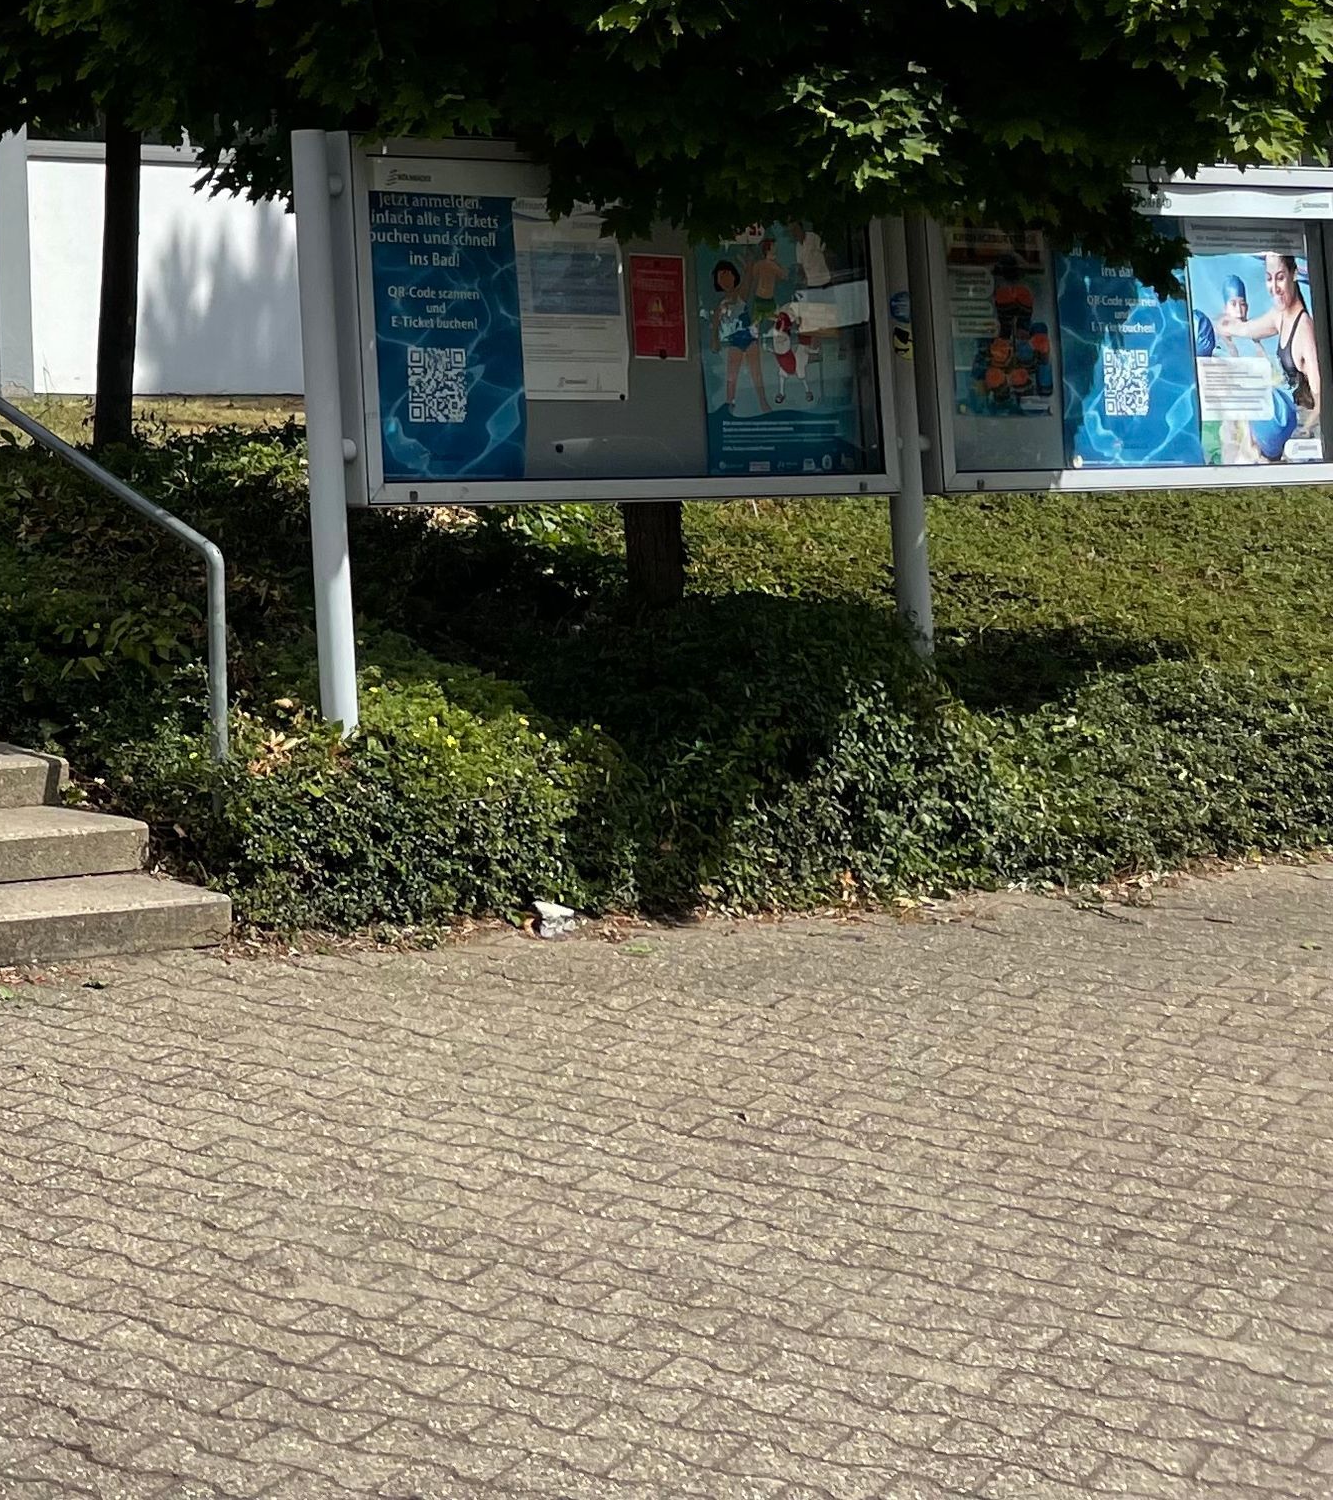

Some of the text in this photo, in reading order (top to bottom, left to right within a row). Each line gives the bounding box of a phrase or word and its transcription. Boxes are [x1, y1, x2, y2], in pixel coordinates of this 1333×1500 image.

[379, 192, 483, 211] Jetzt anmelden.
[371, 209, 499, 229] infach alle E-Tickets
[423, 231, 451, 245] und
[453, 232, 497, 247] schnell
[409, 250, 460, 267] ins Bad!
[387, 285, 480, 301] QR-Code scannen
[425, 302, 447, 314] und
[391, 315, 478, 330] E-Ticket buchen!
